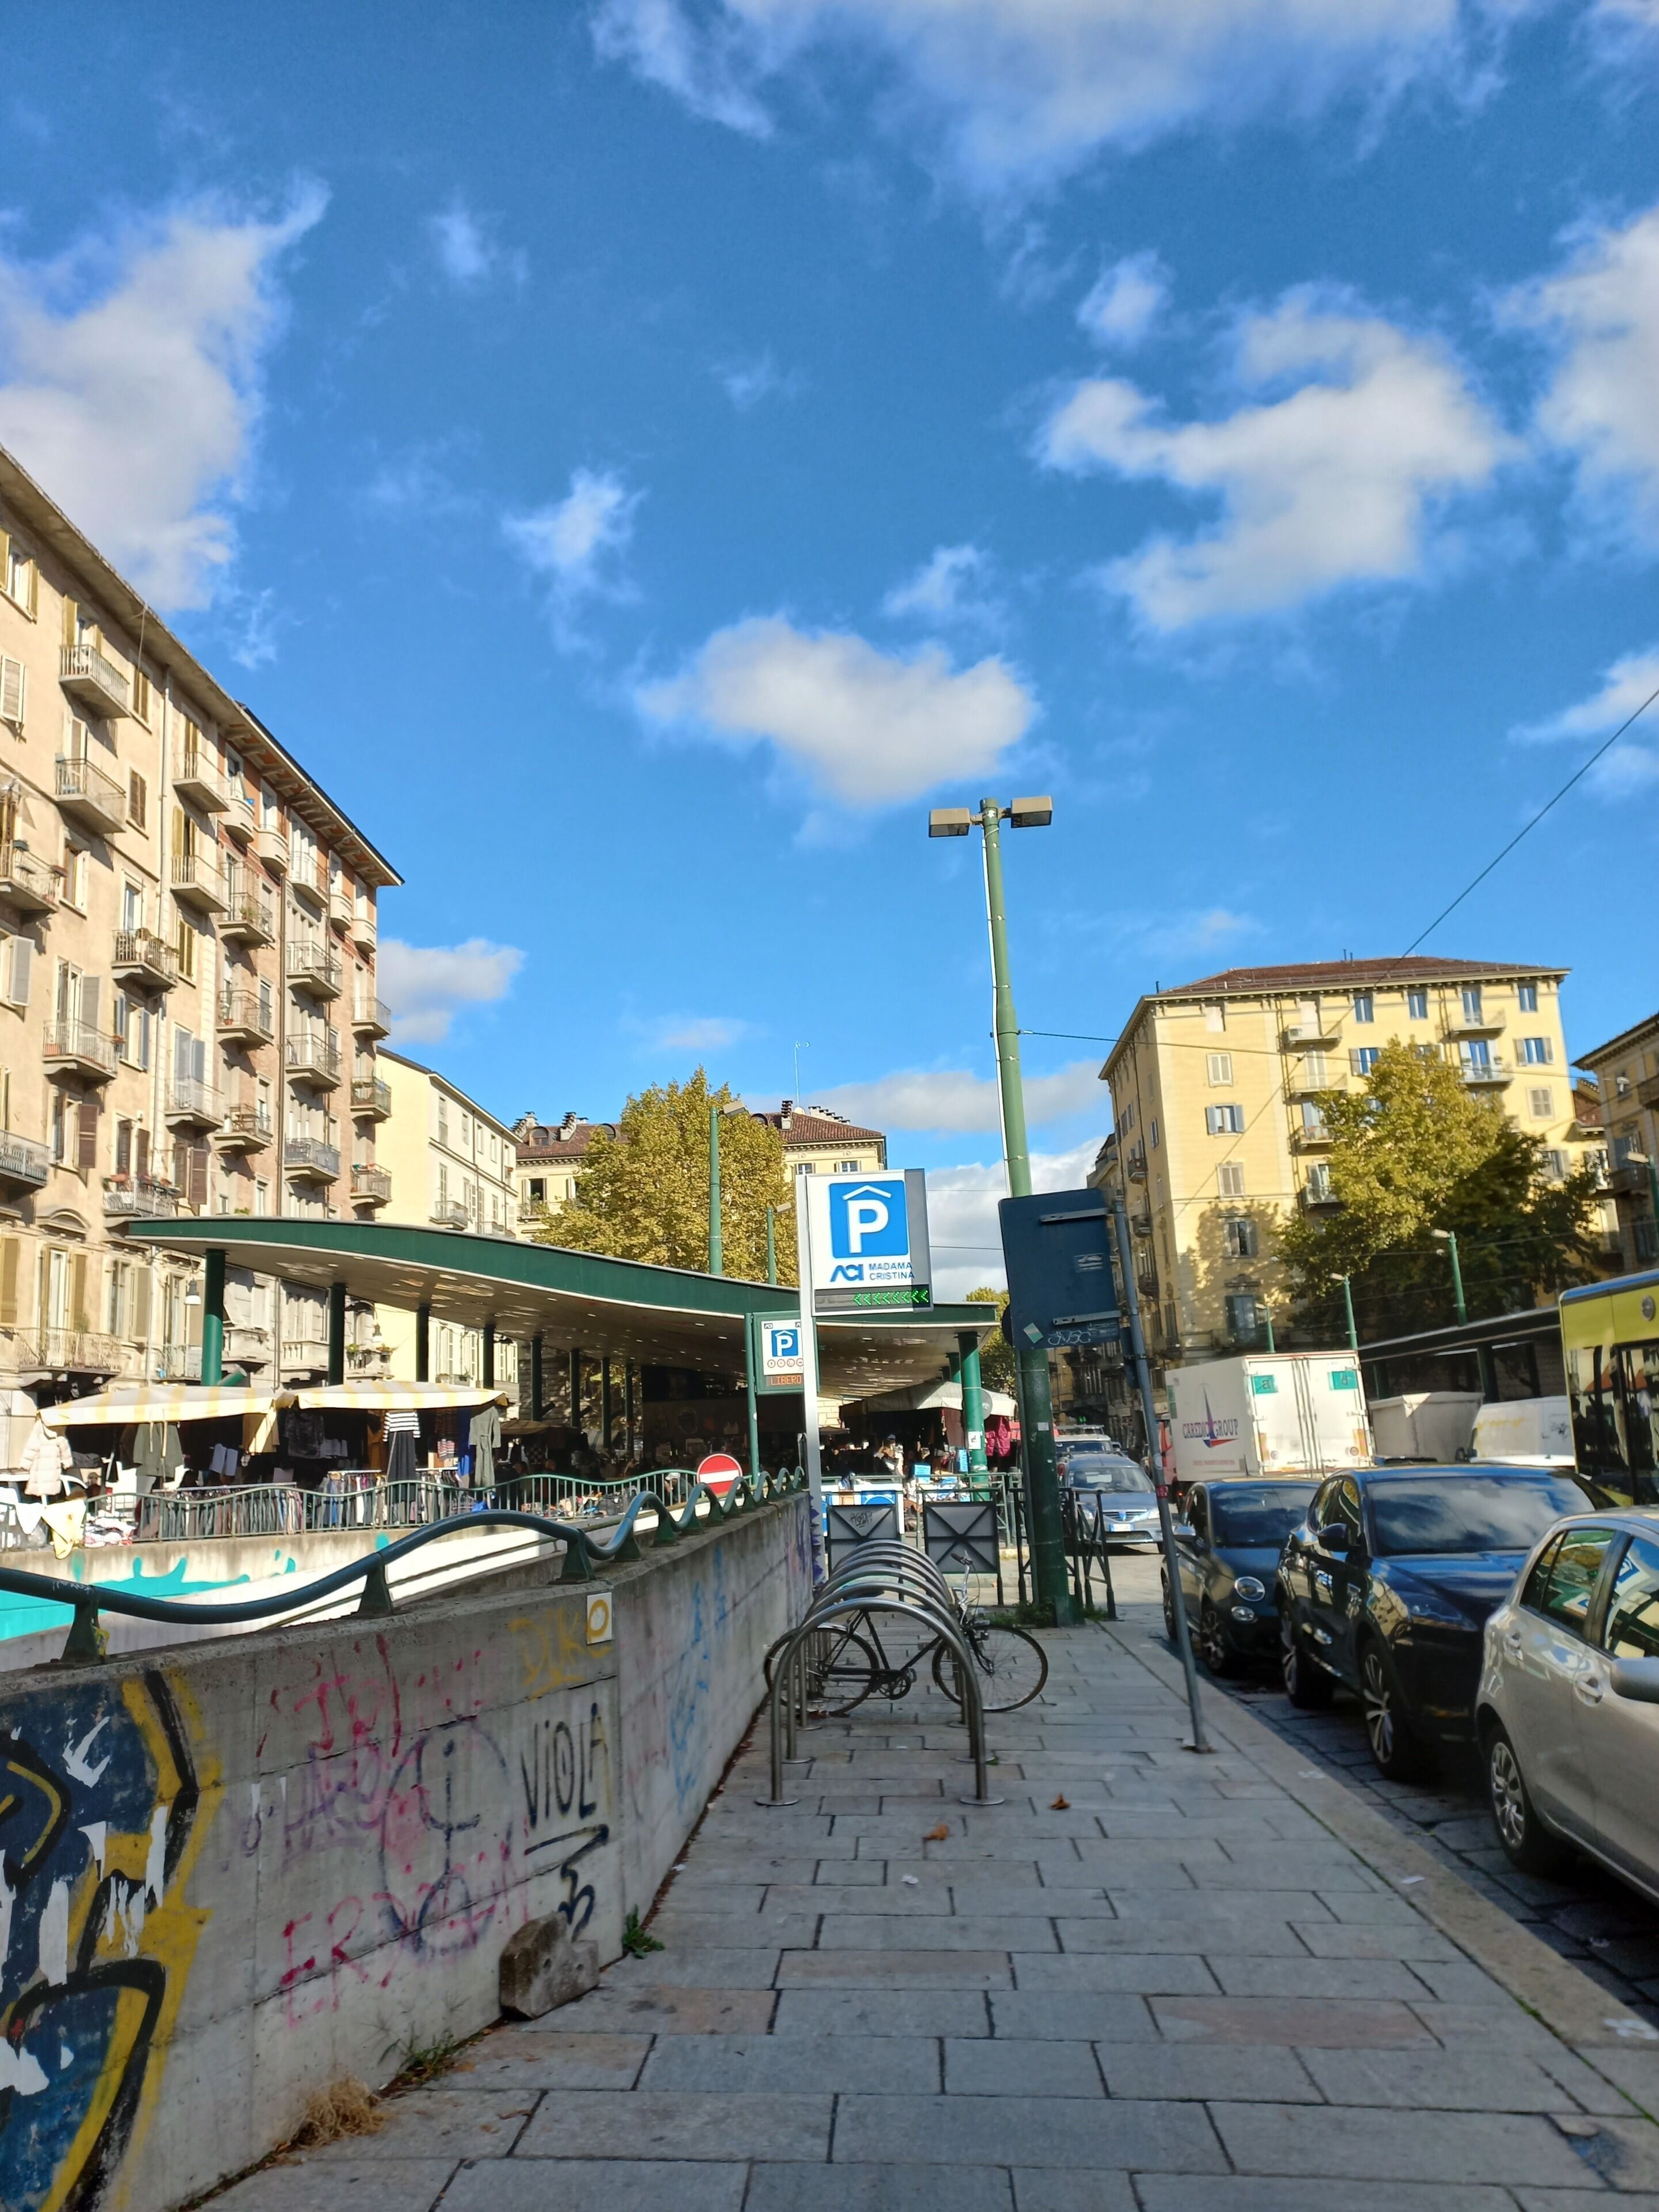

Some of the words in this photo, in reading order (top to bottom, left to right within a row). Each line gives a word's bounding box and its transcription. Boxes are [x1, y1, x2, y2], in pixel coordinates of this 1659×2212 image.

[847, 1199, 889, 1254] P
[830, 1264, 864, 1282] ACI
[869, 1262, 913, 1271] MADAMA
[869, 1271, 915, 1281] CRISTINA
[777, 1335, 793, 1357] P
[771, 1375, 802, 1385] LIBERO
[1213, 1418, 1238, 1437] GROUP
